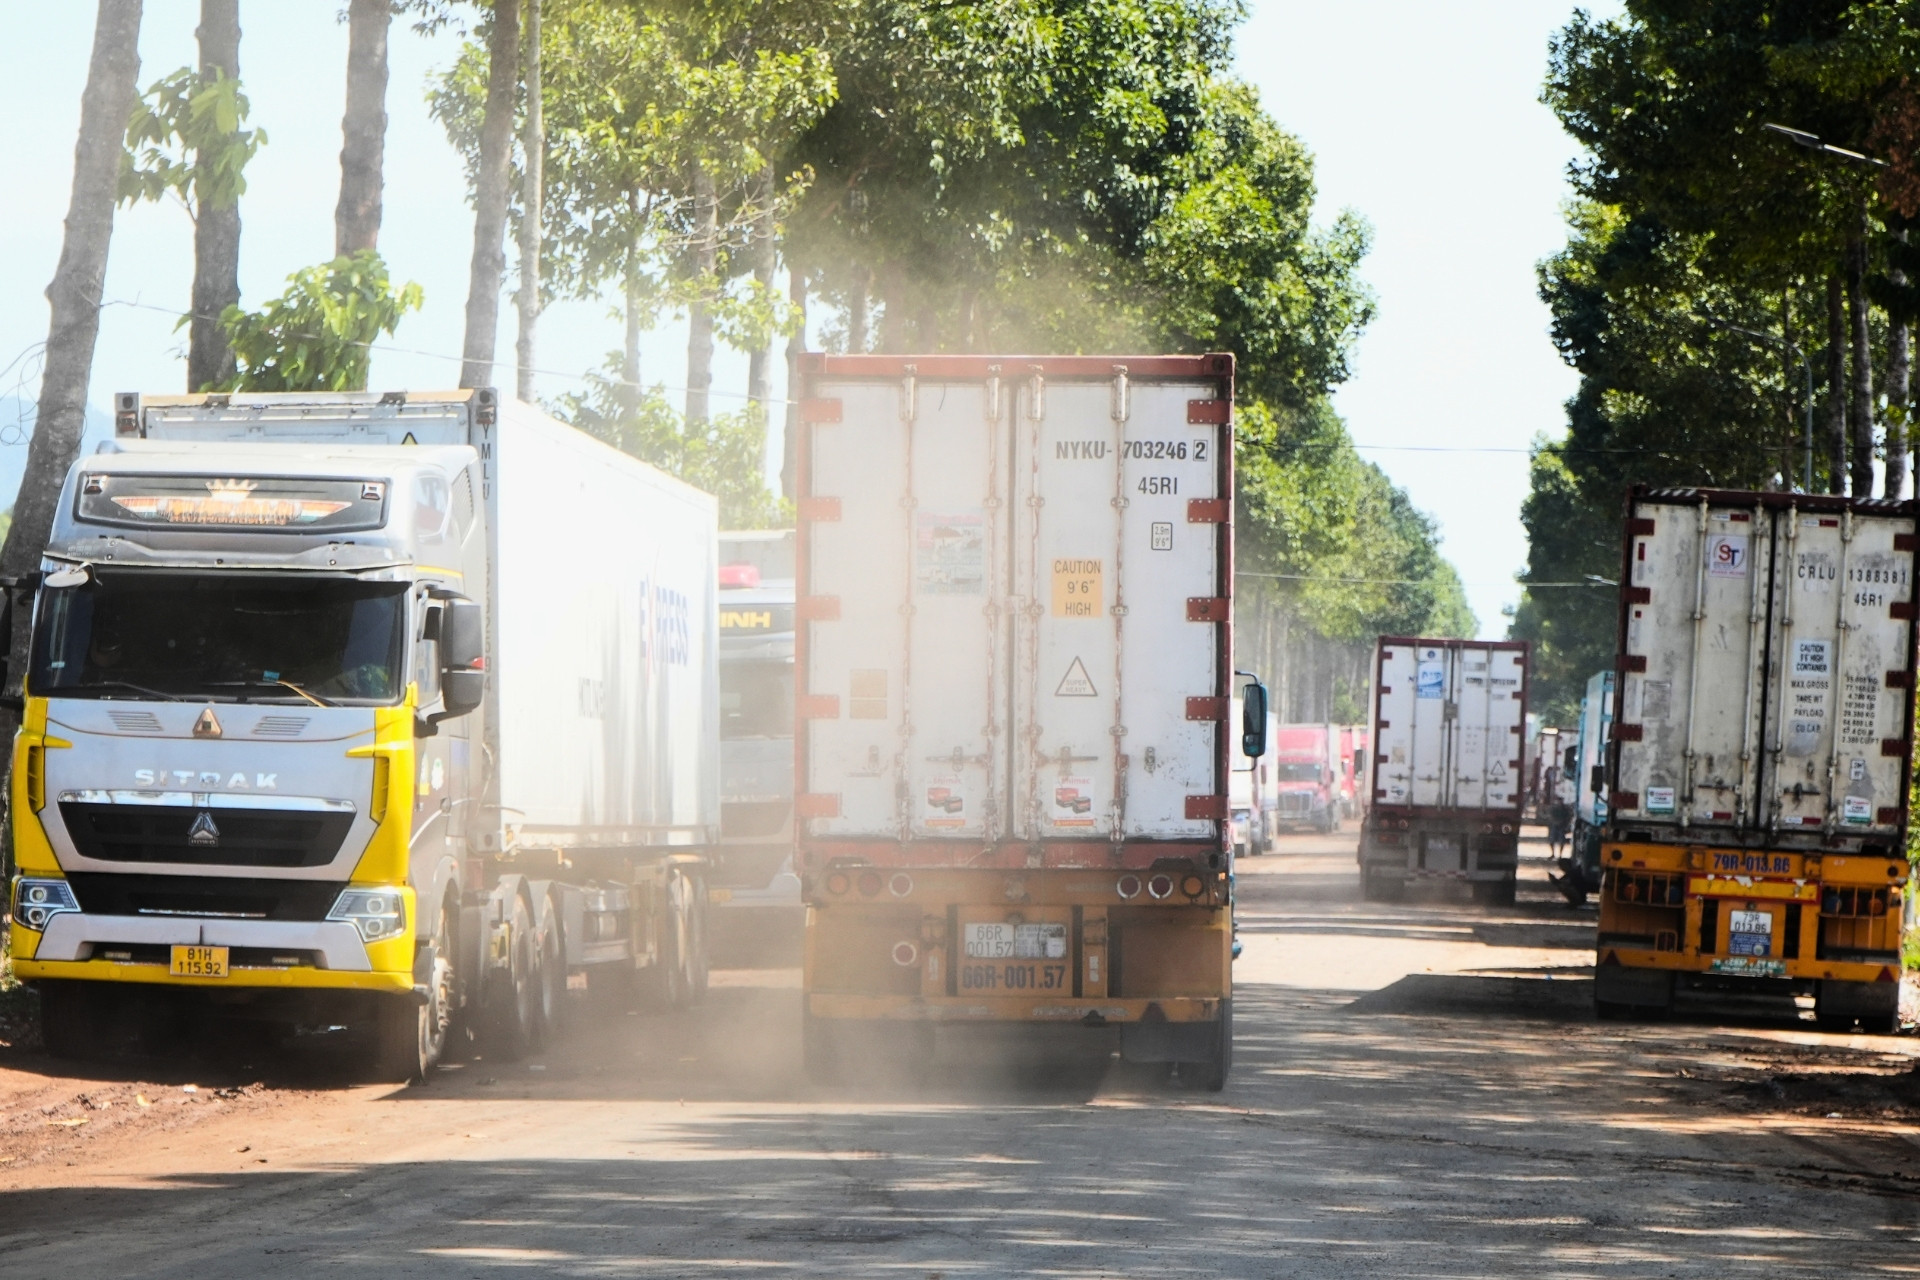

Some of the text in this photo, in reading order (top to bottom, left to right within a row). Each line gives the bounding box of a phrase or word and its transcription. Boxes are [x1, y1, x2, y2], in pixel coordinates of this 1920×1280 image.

[1123, 441, 1187, 460] 703246
[1194, 441, 1206, 460] 2
[481, 423, 491, 500] YMLU
[1054, 560, 1101, 574] CAUTION
[1797, 565, 1836, 580] CRLU
[1854, 593, 1883, 606] 45R1
[1065, 602, 1091, 616] HIGH
[1800, 644, 1824, 653] CAUTION
[1796, 663, 1827, 673] CONTAINER
[135, 769, 278, 790] SITRAK
[976, 925, 1003, 940] 66R
[187, 948, 212, 961] 81H
[967, 941, 1013, 957] 001.57
[178, 961, 221, 975] 115.92
[963, 965, 1066, 989] 66R-001.57
